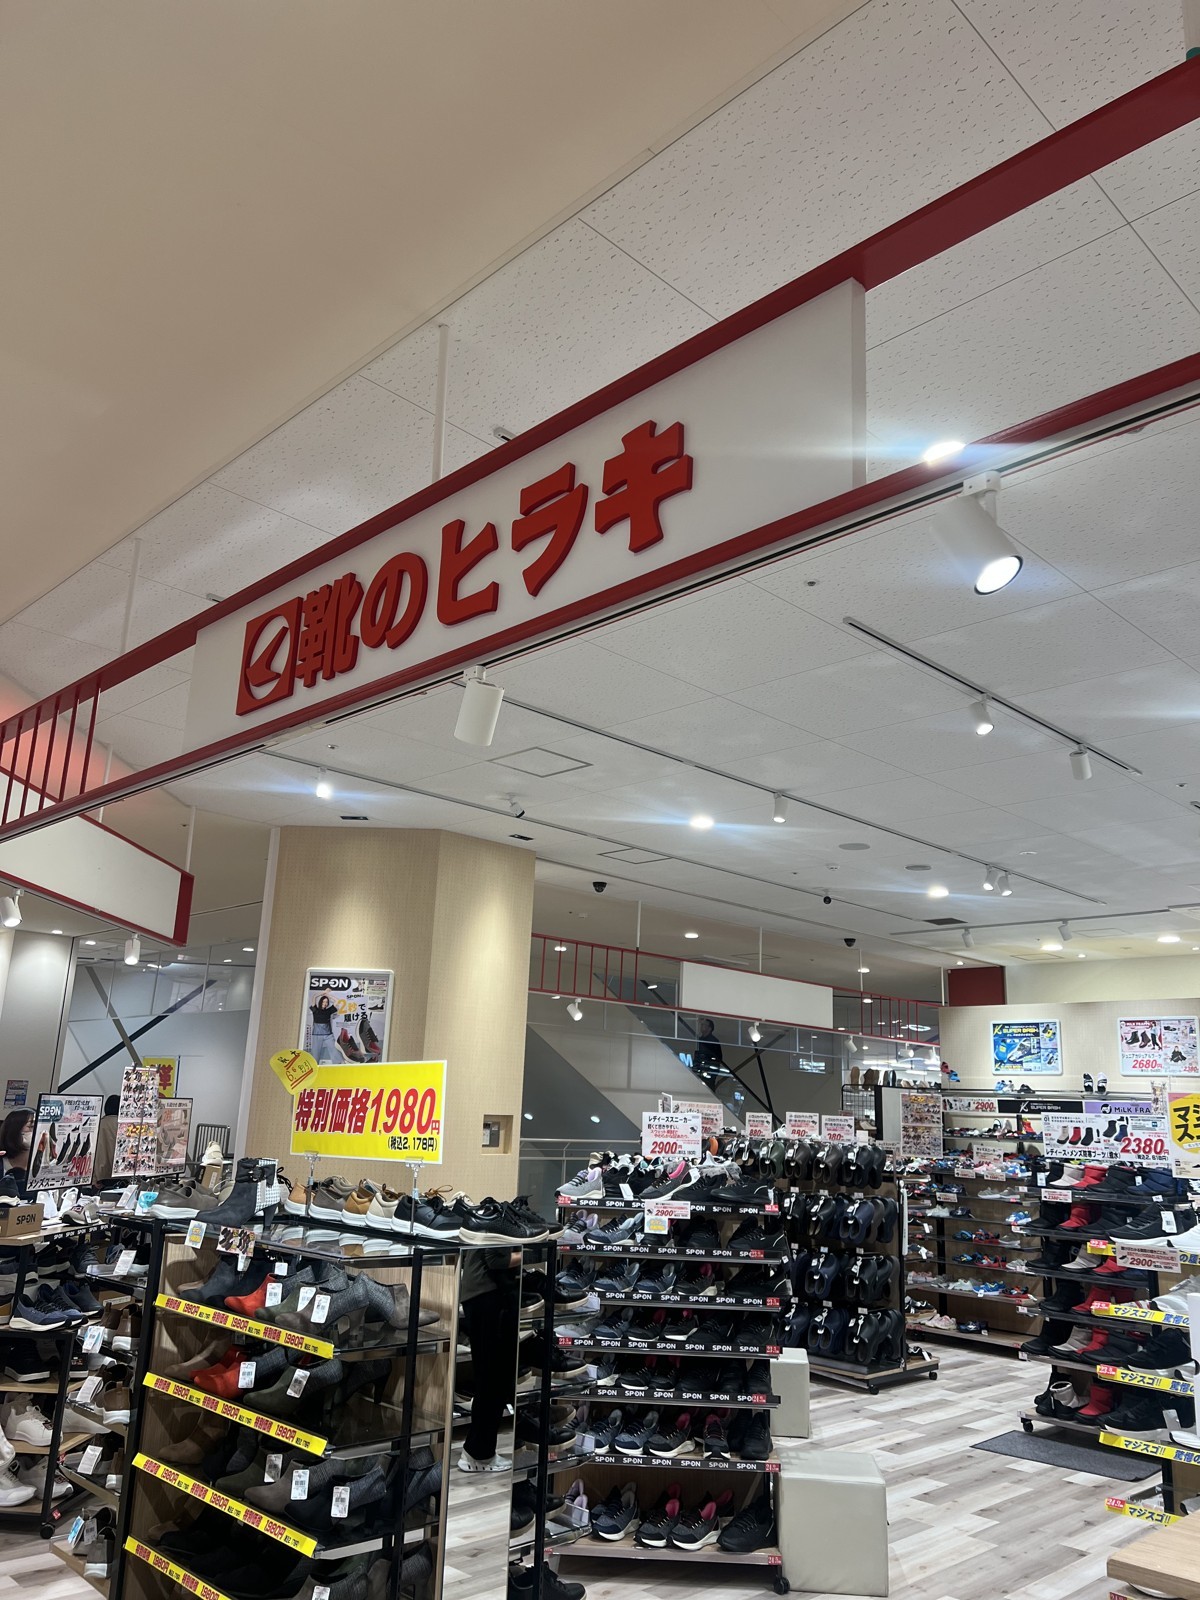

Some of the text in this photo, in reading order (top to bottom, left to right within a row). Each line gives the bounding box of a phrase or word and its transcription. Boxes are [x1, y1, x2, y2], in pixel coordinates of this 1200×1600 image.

[295, 419, 694, 688] 靴のヒラキ
[310, 978, 348, 988] SPON
[39, 1106, 61, 1115] SPON
[16, 1214, 36, 1225] SPON
